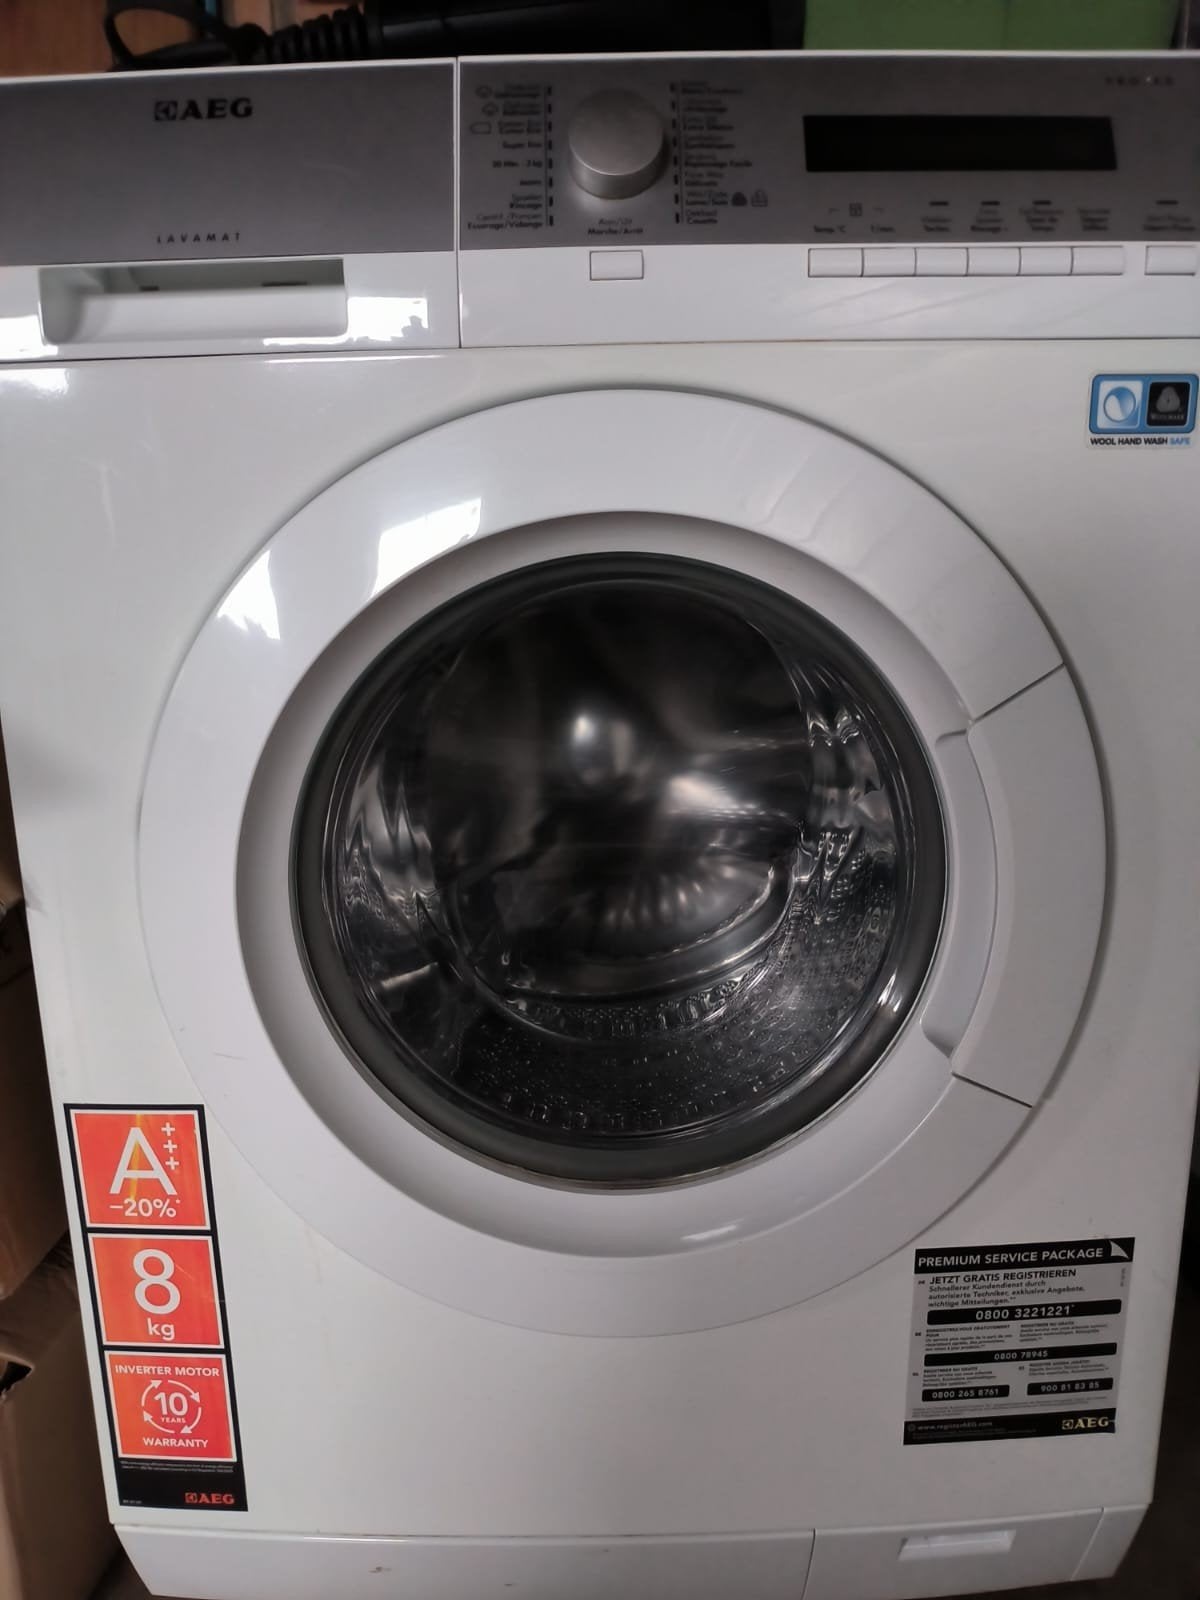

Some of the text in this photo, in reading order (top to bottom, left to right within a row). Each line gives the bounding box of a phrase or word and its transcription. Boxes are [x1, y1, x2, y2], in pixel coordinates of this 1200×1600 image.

[179, 97, 254, 120] AEG
[156, 232, 241, 245] LAVAMAT
[1090, 437, 1116, 446] WOOL
[1117, 437, 1142, 446] HAND
[1143, 437, 1168, 446] WASH
[918, 1247, 1104, 1268] PREMIUM SERVICE PACKAGE
[132, 1248, 182, 1316] 8
[929, 1275, 960, 1285] JETZT
[962, 1272, 1001, 1283] GRATIS
[1003, 1268, 1077, 1281] REGISTRIEREN
[928, 1279, 1046, 1293] Schnellerer Kundendienst durch
[928, 1291, 971, 1301] autorisierte
[1011, 1287, 1045, 1297] exklusive
[975, 1309, 1009, 1321] 0800
[148, 1317, 175, 1341] kg
[993, 1352, 1018, 1361] 0800
[115, 1364, 220, 1377] INVERTER MOTOR
[931, 1390, 955, 1399] 0800
[957, 1389, 975, 1398] 265
[1040, 1383, 1058, 1393] 900
[154, 1391, 189, 1416] 10
[161, 1416, 186, 1424] YEARS
[1073, 1416, 1110, 1430] AEG
[142, 1436, 209, 1449] WARRANTY
[199, 1492, 235, 1505] AEG
